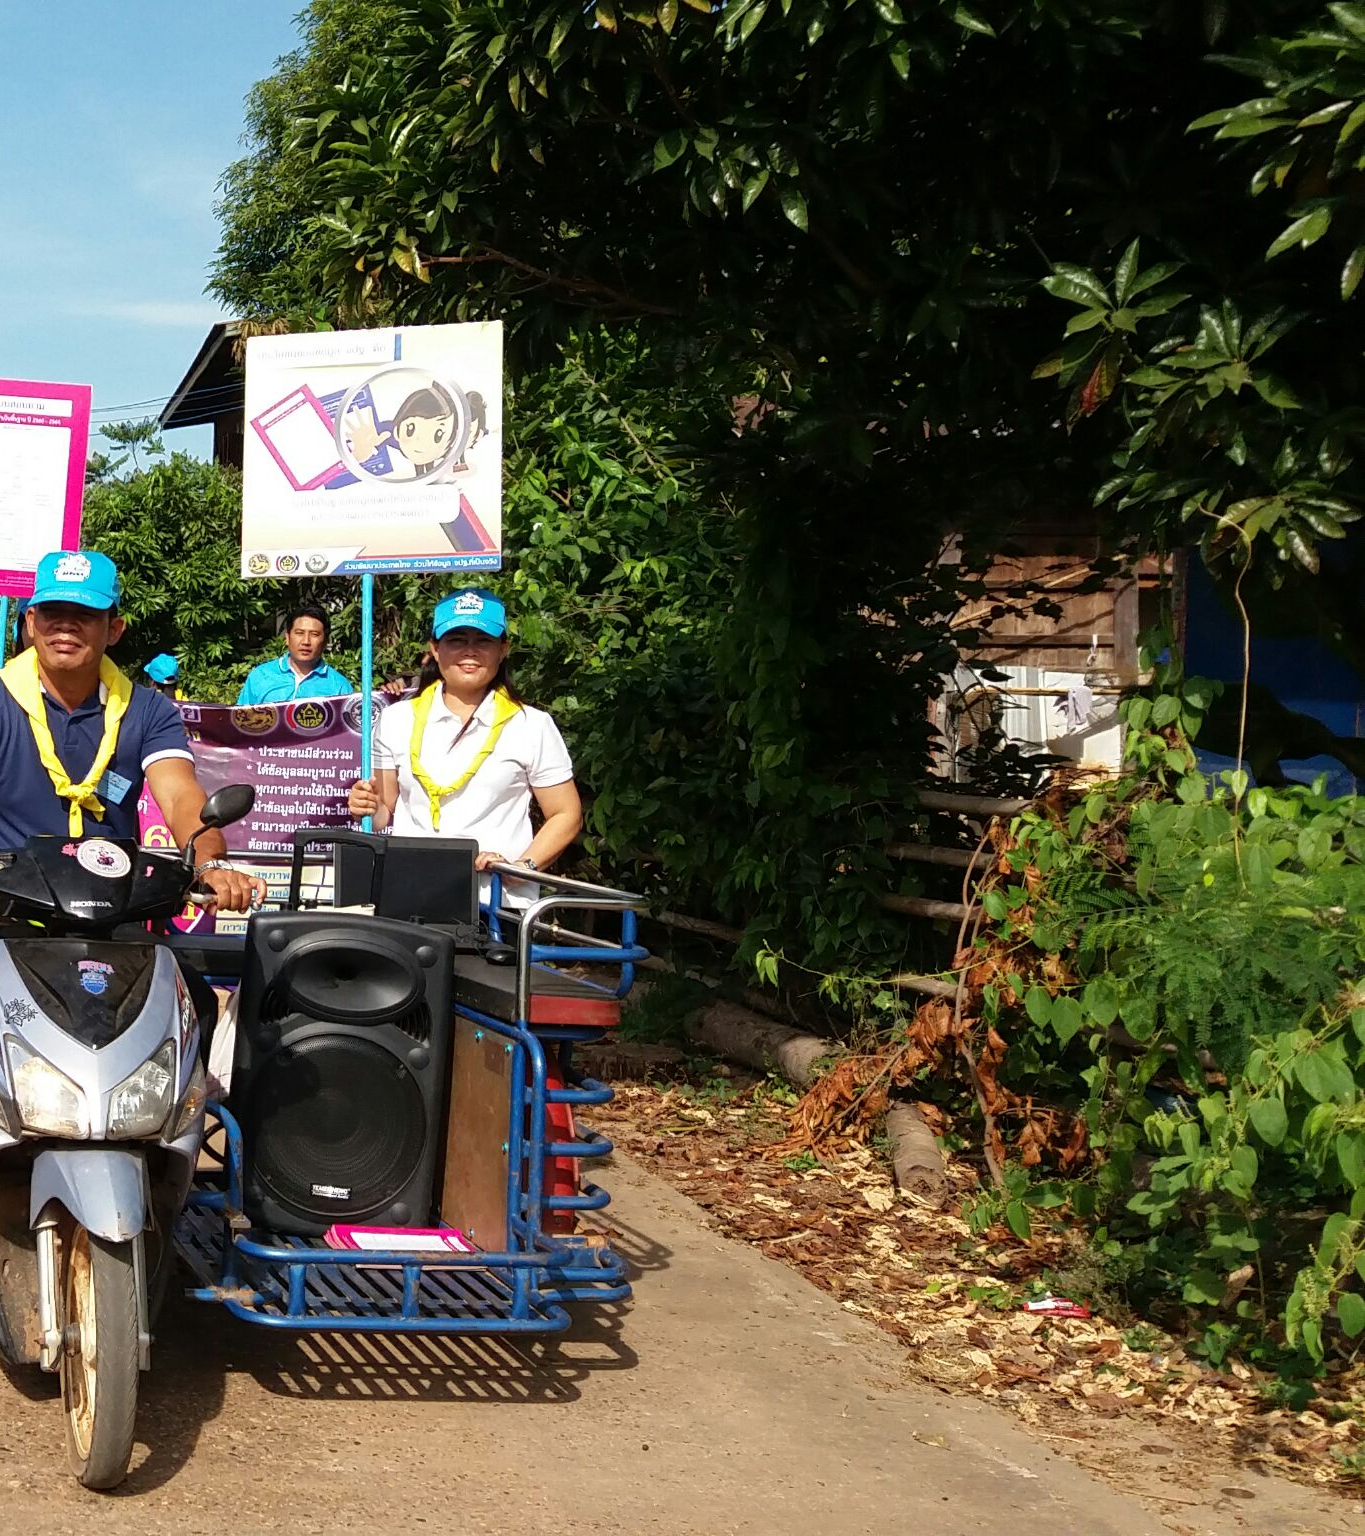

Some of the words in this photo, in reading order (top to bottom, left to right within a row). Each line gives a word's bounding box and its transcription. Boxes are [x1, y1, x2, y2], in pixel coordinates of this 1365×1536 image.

[258, 745, 353, 760] ประชาชนมีส่วนร่วม
[256, 762, 337, 782] ได้ข้อมูลสมบูรณ์
[339, 764, 362, 782] ถูกต้
[69, 900, 113, 908] HONDA
